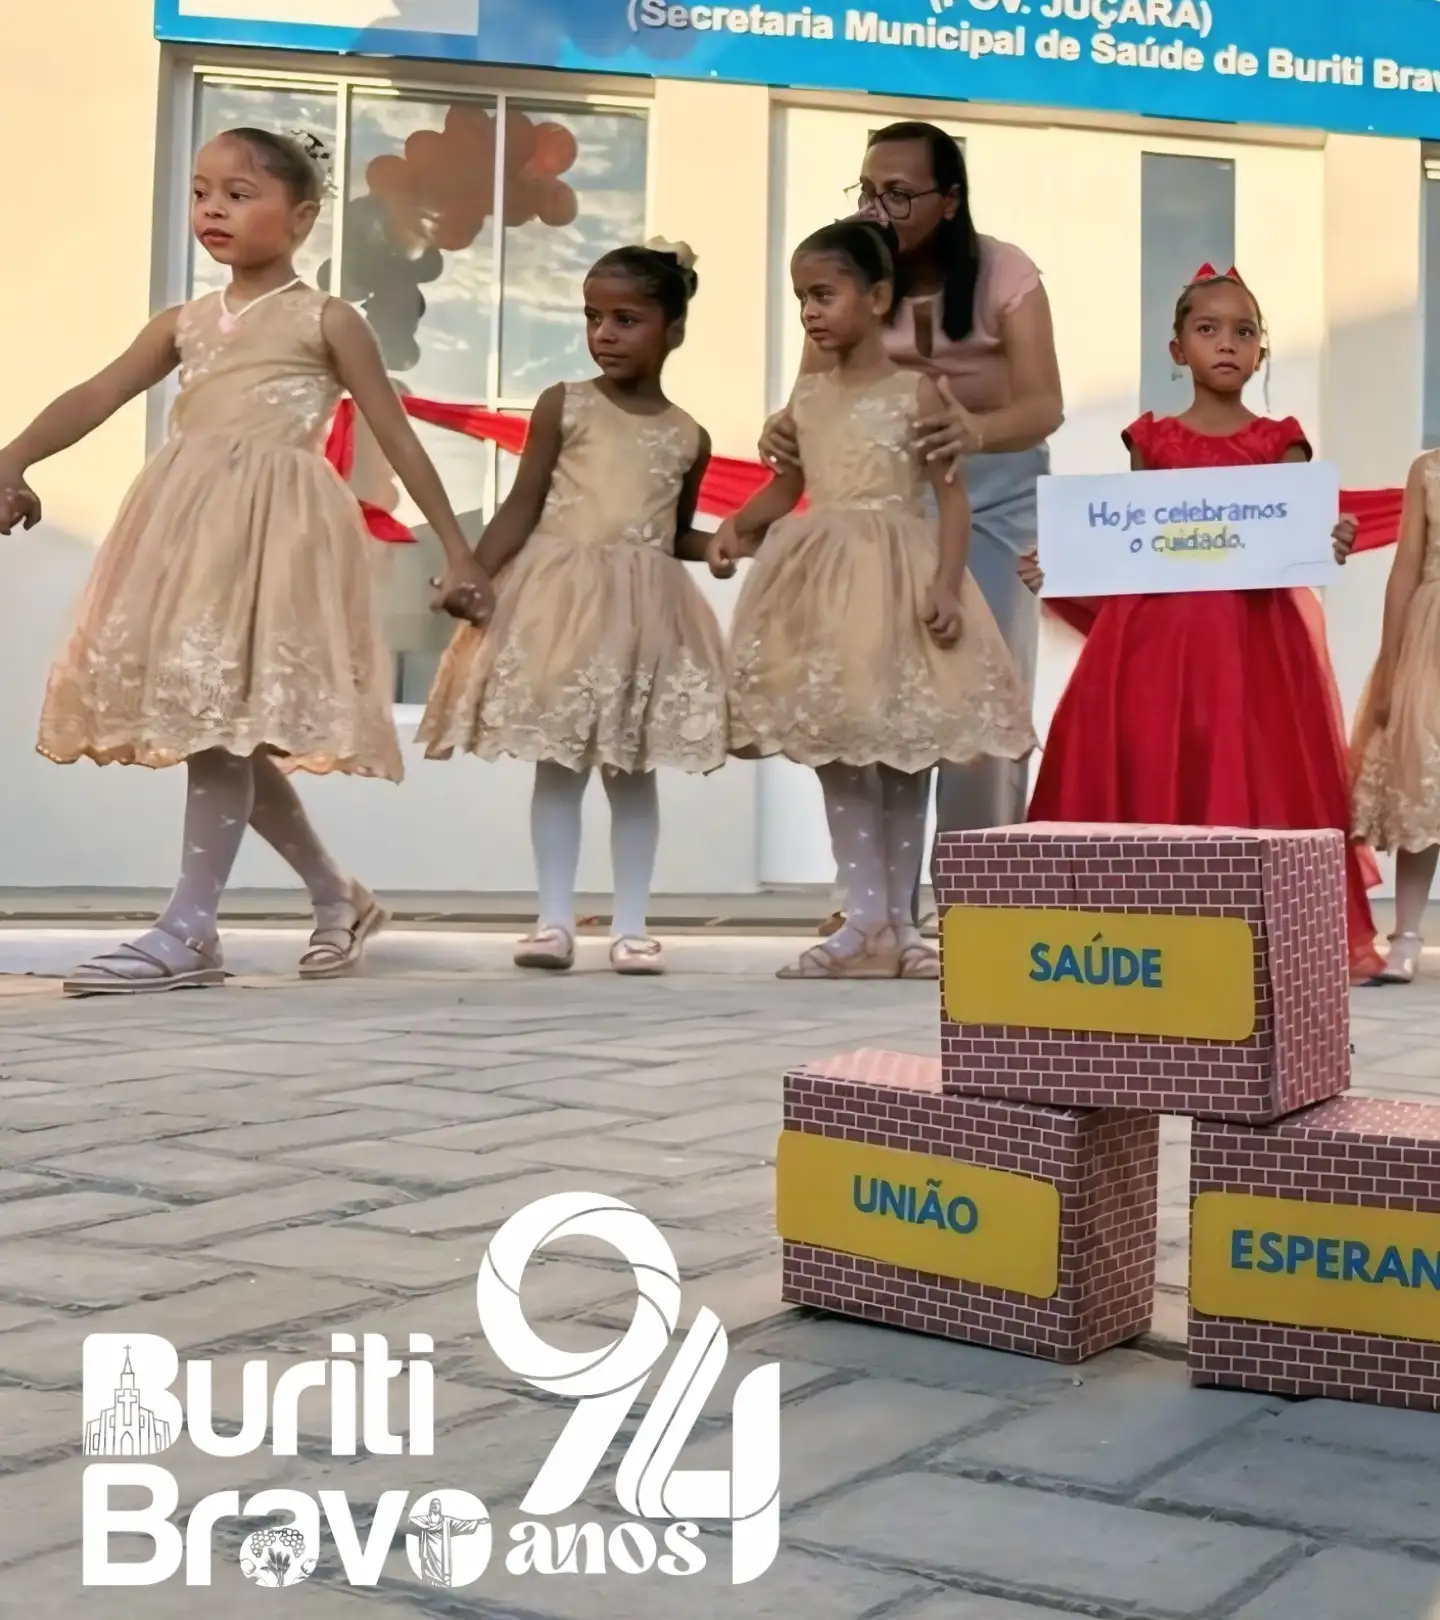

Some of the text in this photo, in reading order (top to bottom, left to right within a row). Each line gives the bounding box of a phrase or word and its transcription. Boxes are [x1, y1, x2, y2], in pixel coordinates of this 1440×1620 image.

[627, 0, 834, 40] (Secretaria
[844, 9, 1026, 60] Municipal
[1034, 28, 1081, 61] de
[1090, 32, 1205, 72] Saúde
[1213, 44, 1259, 76] de
[1267, 47, 1364, 86] Buriti
[1087, 498, 1289, 532] Hoje celebramos
[1129, 537, 1144, 554] o
[1028, 933, 1163, 989] SAÚDE
[852, 1177, 979, 1235] UNIÃO
